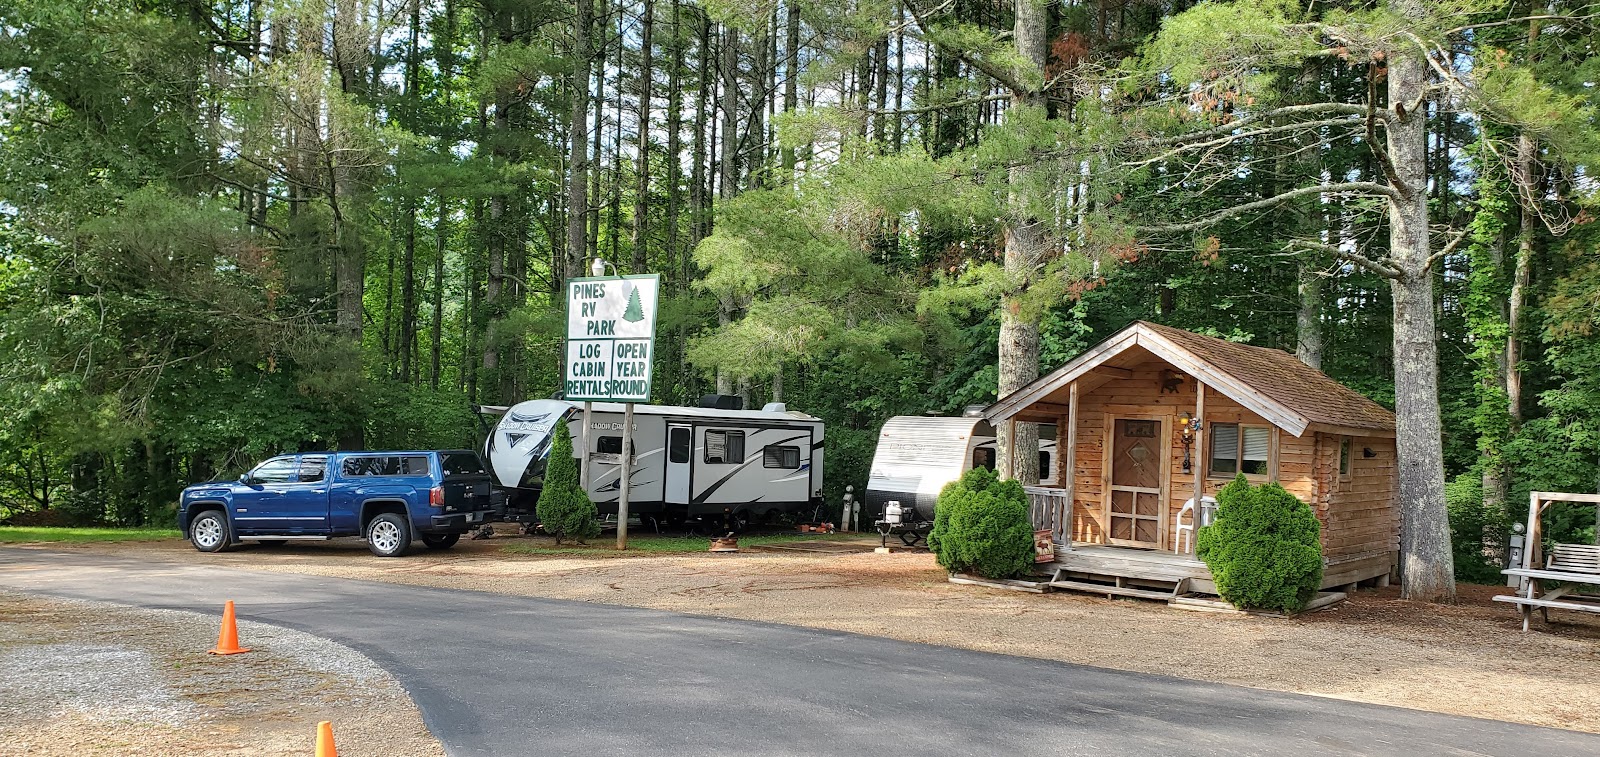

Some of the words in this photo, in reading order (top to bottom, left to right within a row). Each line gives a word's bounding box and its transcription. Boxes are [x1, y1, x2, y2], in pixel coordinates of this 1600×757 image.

[573, 282, 606, 300] PINES
[581, 301, 597, 318] RV
[587, 320, 616, 336] PARK
[579, 343, 601, 359] LOG
[616, 343, 648, 359] OPEN
[572, 361, 606, 377] CABIN
[616, 361, 646, 377] YEAR
[567, 380, 611, 396] RENTALS
[612, 379, 647, 396] ROUND
